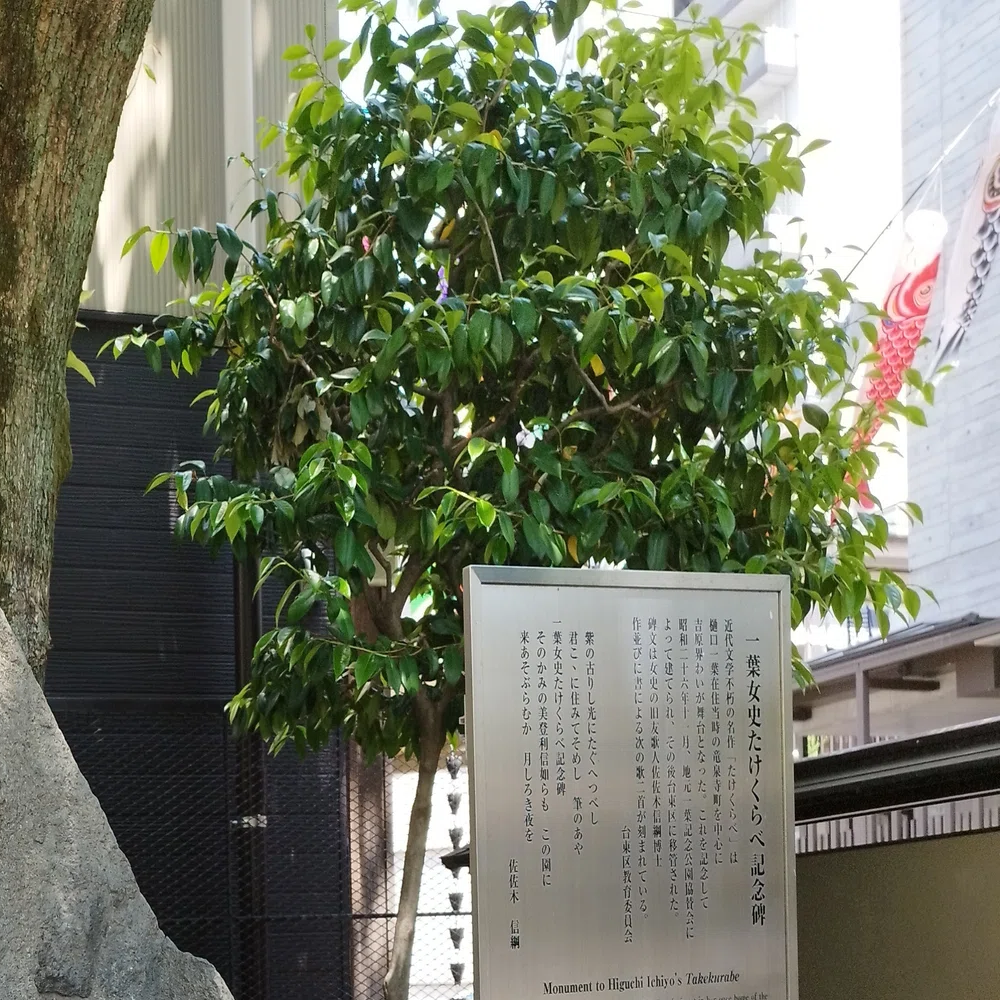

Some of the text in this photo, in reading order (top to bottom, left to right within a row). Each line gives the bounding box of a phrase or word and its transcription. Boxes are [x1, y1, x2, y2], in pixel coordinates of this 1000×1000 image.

[552, 620, 566, 796] 一葉女史たけくらべ記念碑
[585, 631, 599, 825] 紫の古りし光にたぐへつべし
[523, 752, 534, 842] 月しろき夜を
[745, 637, 766, 927] 一葉女史たけくらべ記念碑
[621, 825, 633, 943] 台東区教育委員会
[543, 970, 739, 994] Monument to Higuchi Ichiyo's Takekurabe
[750, 991, 756, 1000] of
[758, 990, 767, 1000] the
